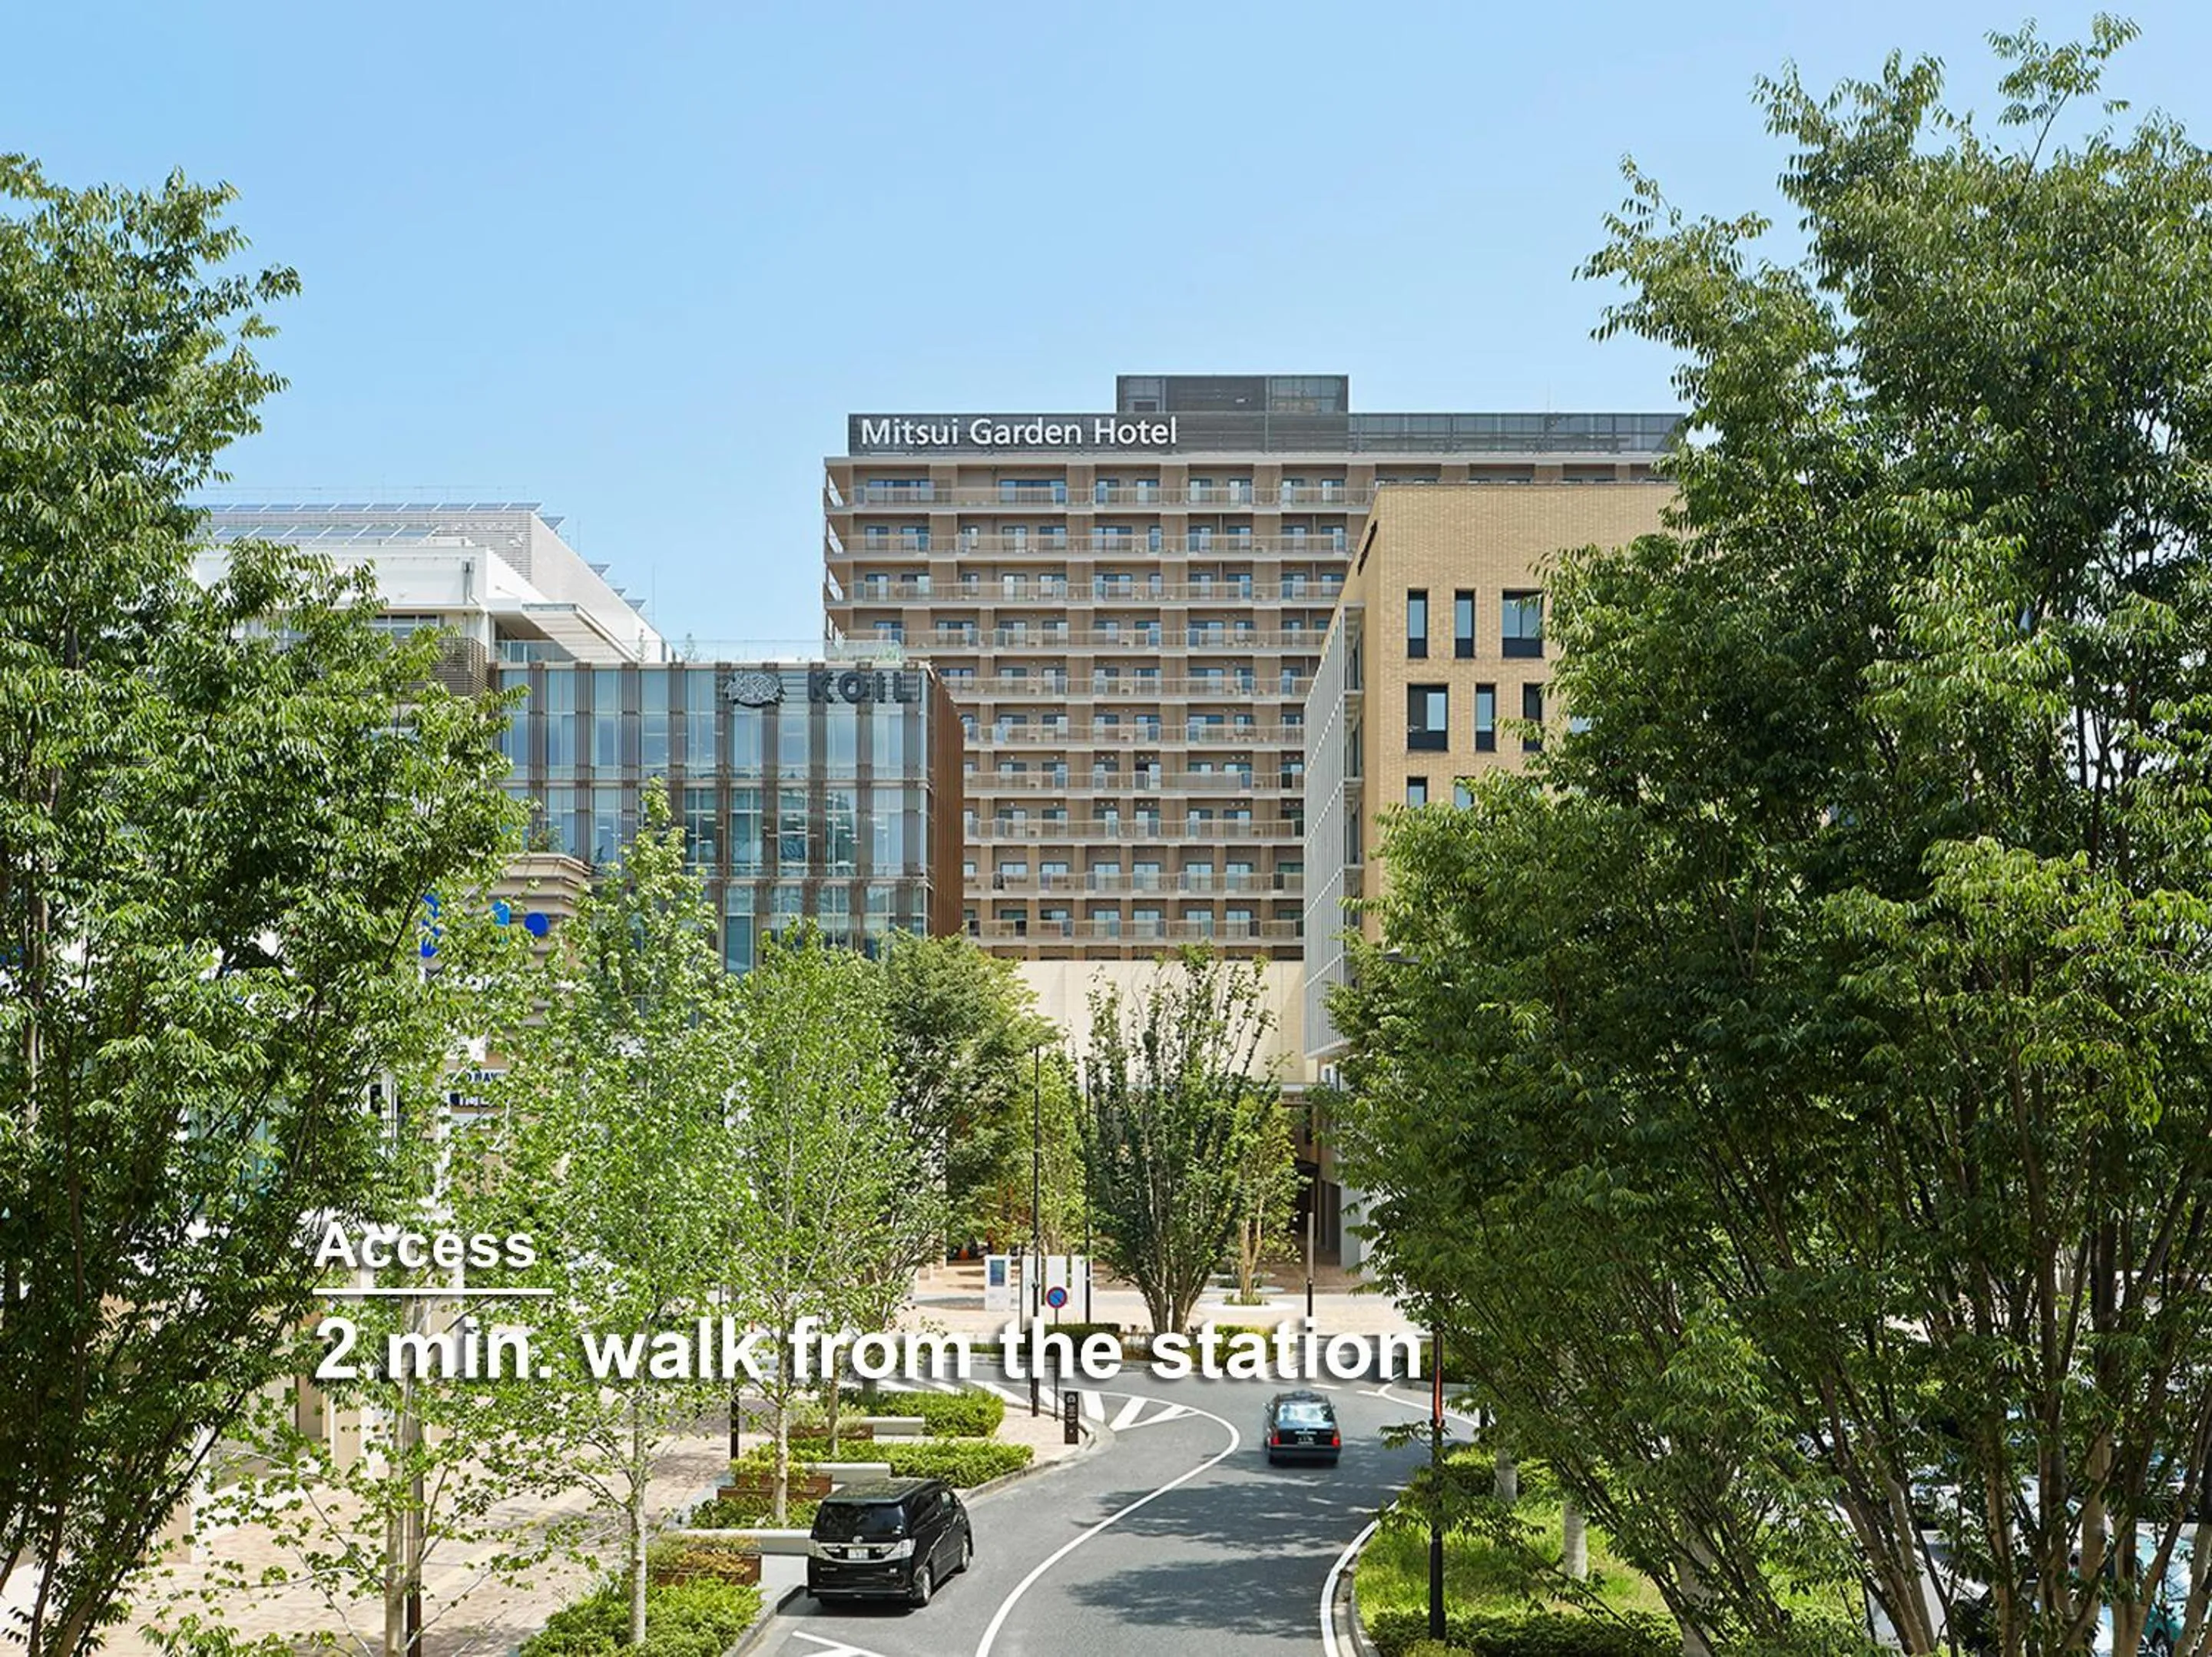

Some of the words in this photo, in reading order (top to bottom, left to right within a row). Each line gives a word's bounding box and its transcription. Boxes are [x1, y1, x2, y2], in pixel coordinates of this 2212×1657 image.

[861, 417, 959, 445] Mitsui
[969, 416, 1082, 446] Garden
[1094, 415, 1177, 445] Hotel
[808, 670, 920, 704] KOIL
